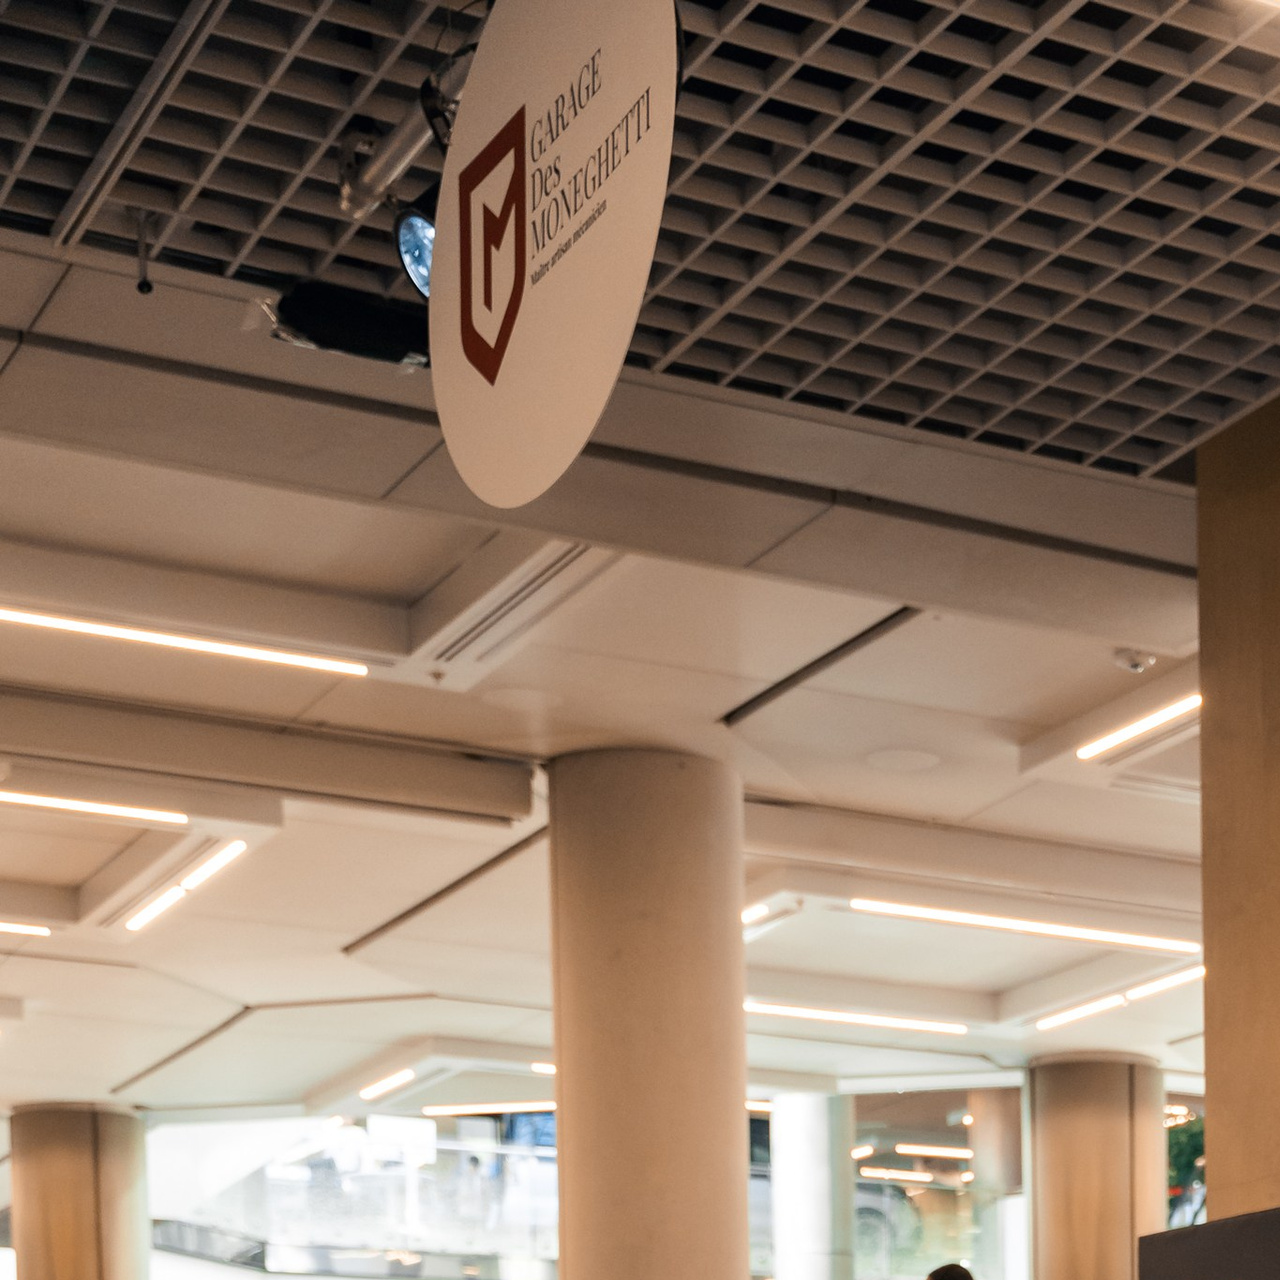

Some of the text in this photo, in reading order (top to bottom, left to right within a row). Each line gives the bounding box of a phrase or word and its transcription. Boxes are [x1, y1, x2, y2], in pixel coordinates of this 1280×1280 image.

[530, 48, 601, 163] GARAGE
[530, 86, 651, 259] MONEGHETTI
[530, 156, 561, 213] Des
[551, 238, 572, 267] artisan
